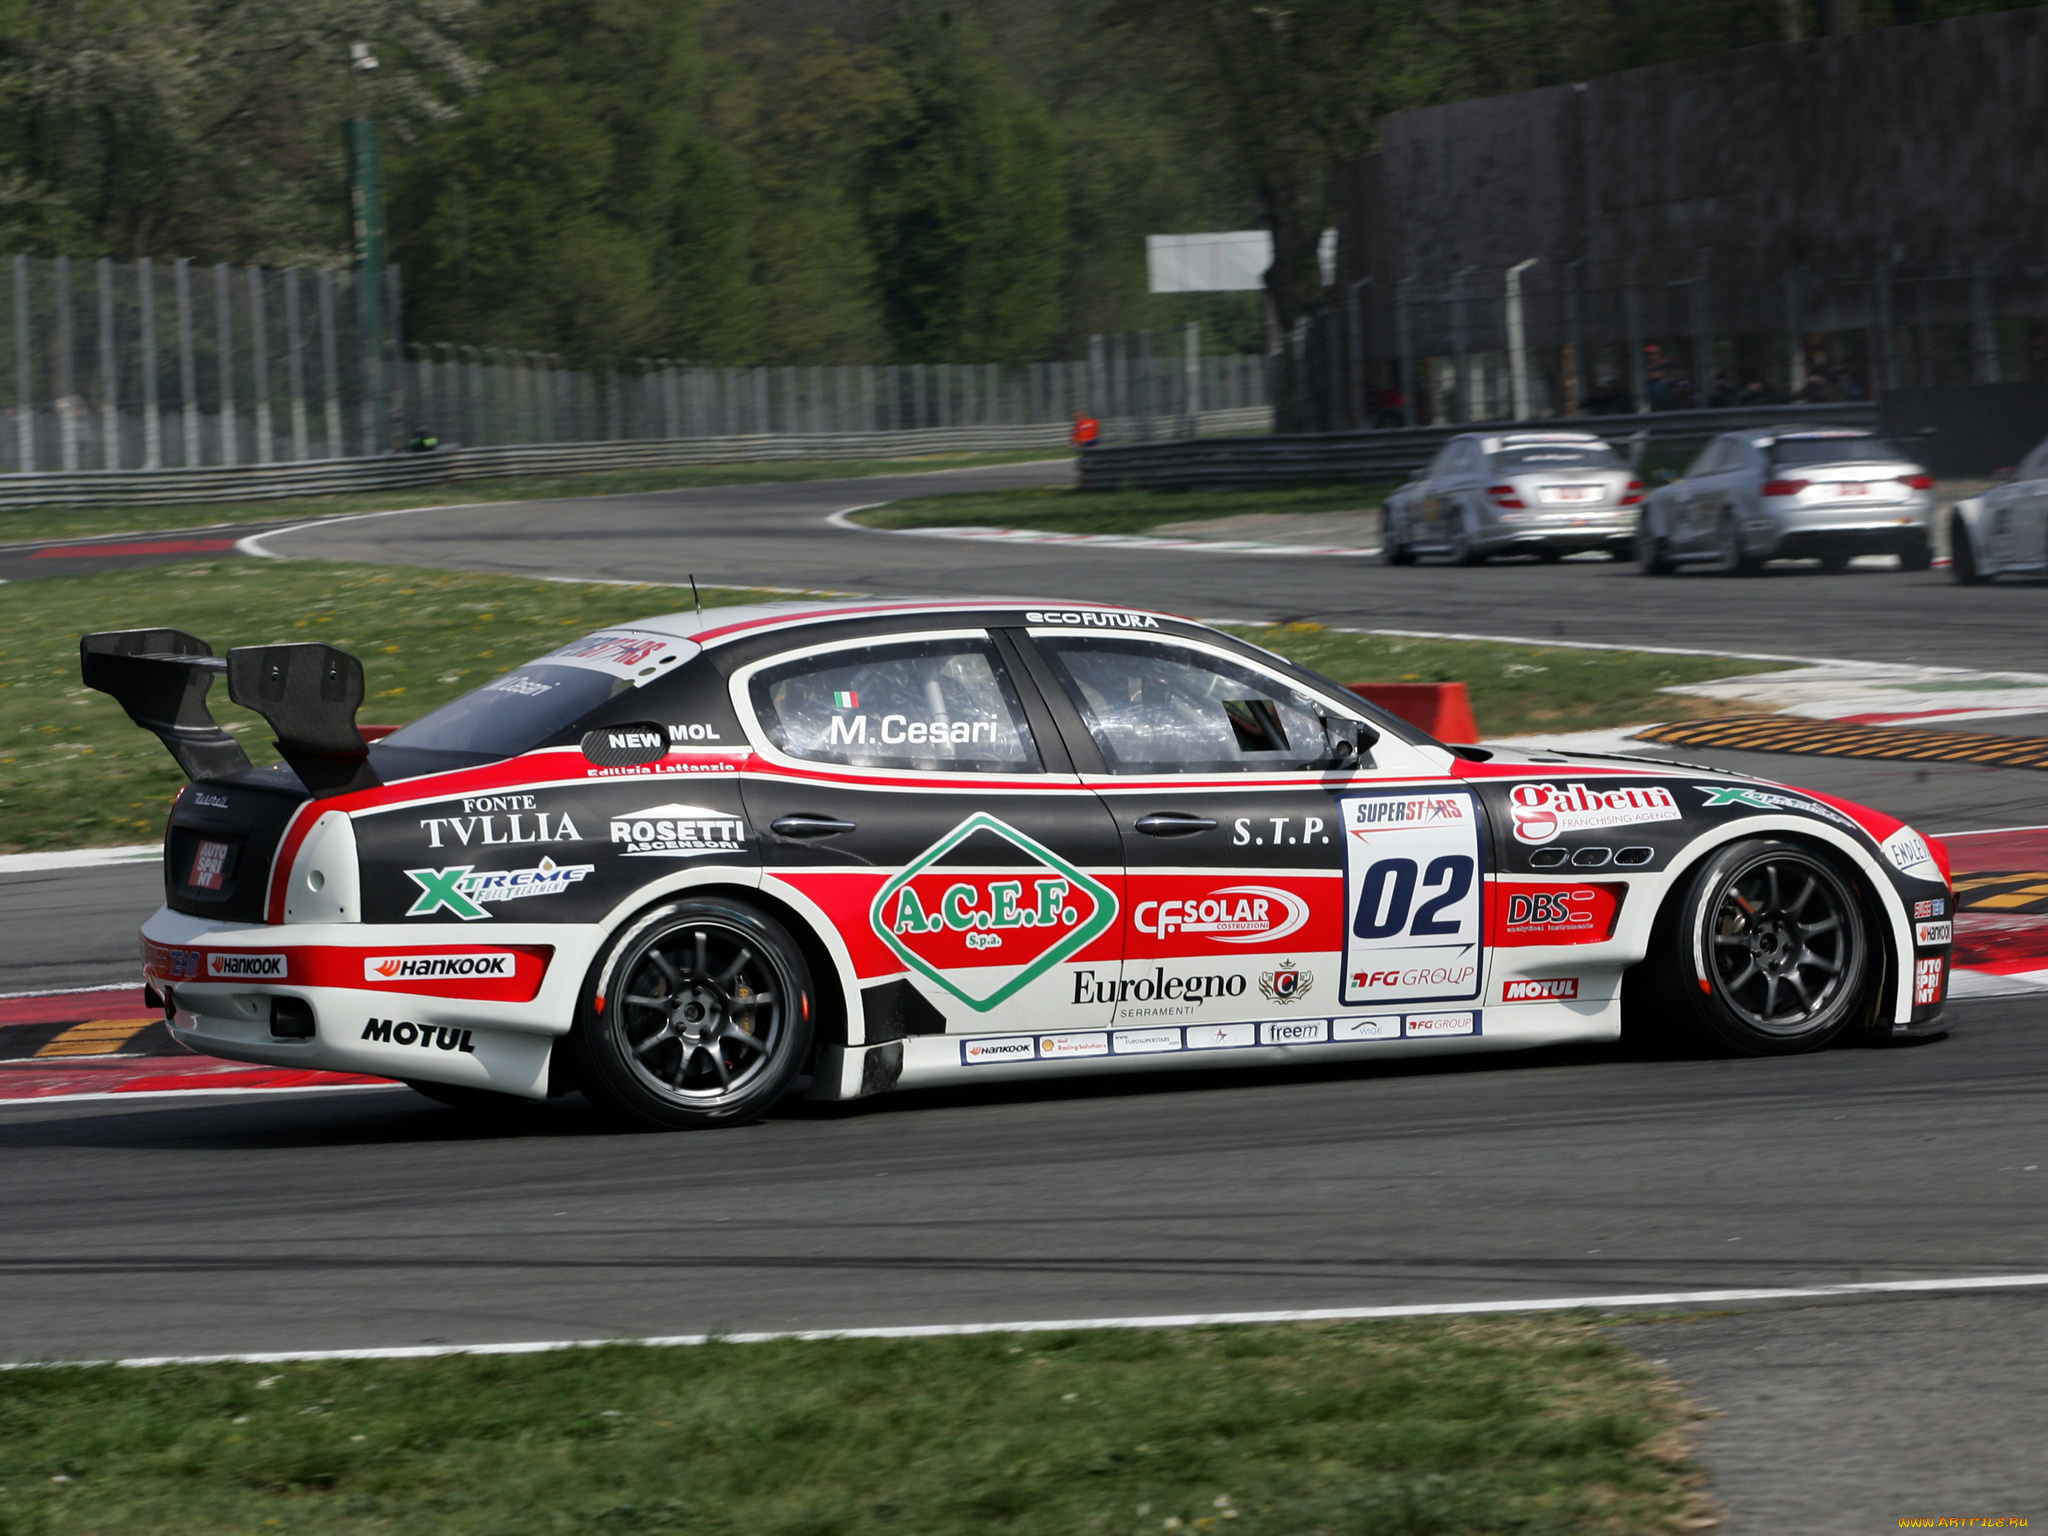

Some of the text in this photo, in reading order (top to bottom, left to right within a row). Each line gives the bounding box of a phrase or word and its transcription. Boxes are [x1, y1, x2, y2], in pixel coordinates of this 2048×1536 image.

[608, 724, 720, 749] NEW MOL
[587, 762, 735, 777] Edilizia Lattanzio
[462, 795, 537, 813] FONTE
[1357, 798, 1463, 824] SUPERSTARS
[1513, 785, 1676, 840] gabetti
[1561, 810, 1678, 828] FRANCHISING AGENCY
[420, 812, 583, 848] TVLLIA
[610, 820, 745, 843] ROSETTI
[1233, 817, 1330, 846] S.T.P.
[200, 843, 228, 860] AUTO
[627, 841, 739, 853] ASCENSORI
[197, 858, 222, 874] SPRI
[197, 872, 213, 887] NT
[405, 866, 589, 919] XTREME
[476, 881, 567, 901] FUEL TREATMENT
[1353, 855, 1475, 939] 02
[894, 879, 1078, 935] A.C.E.F.
[1507, 892, 1570, 925] DBS
[1216, 922, 1269, 931] COSTRUZIONI
[967, 934, 1001, 949] S.p.a.
[1369, 966, 1475, 987] FG GROUP
[1071, 967, 1247, 1007] Eurolegno
[1507, 981, 1575, 999] MOTUL
[1918, 988, 1934, 1003] NT
[1120, 1006, 1194, 1018] SERRAMENTI
[1270, 1024, 1318, 1041] freem
[1417, 1019, 1471, 1029] FG GROUP
[360, 1018, 475, 1053] MOTUL
